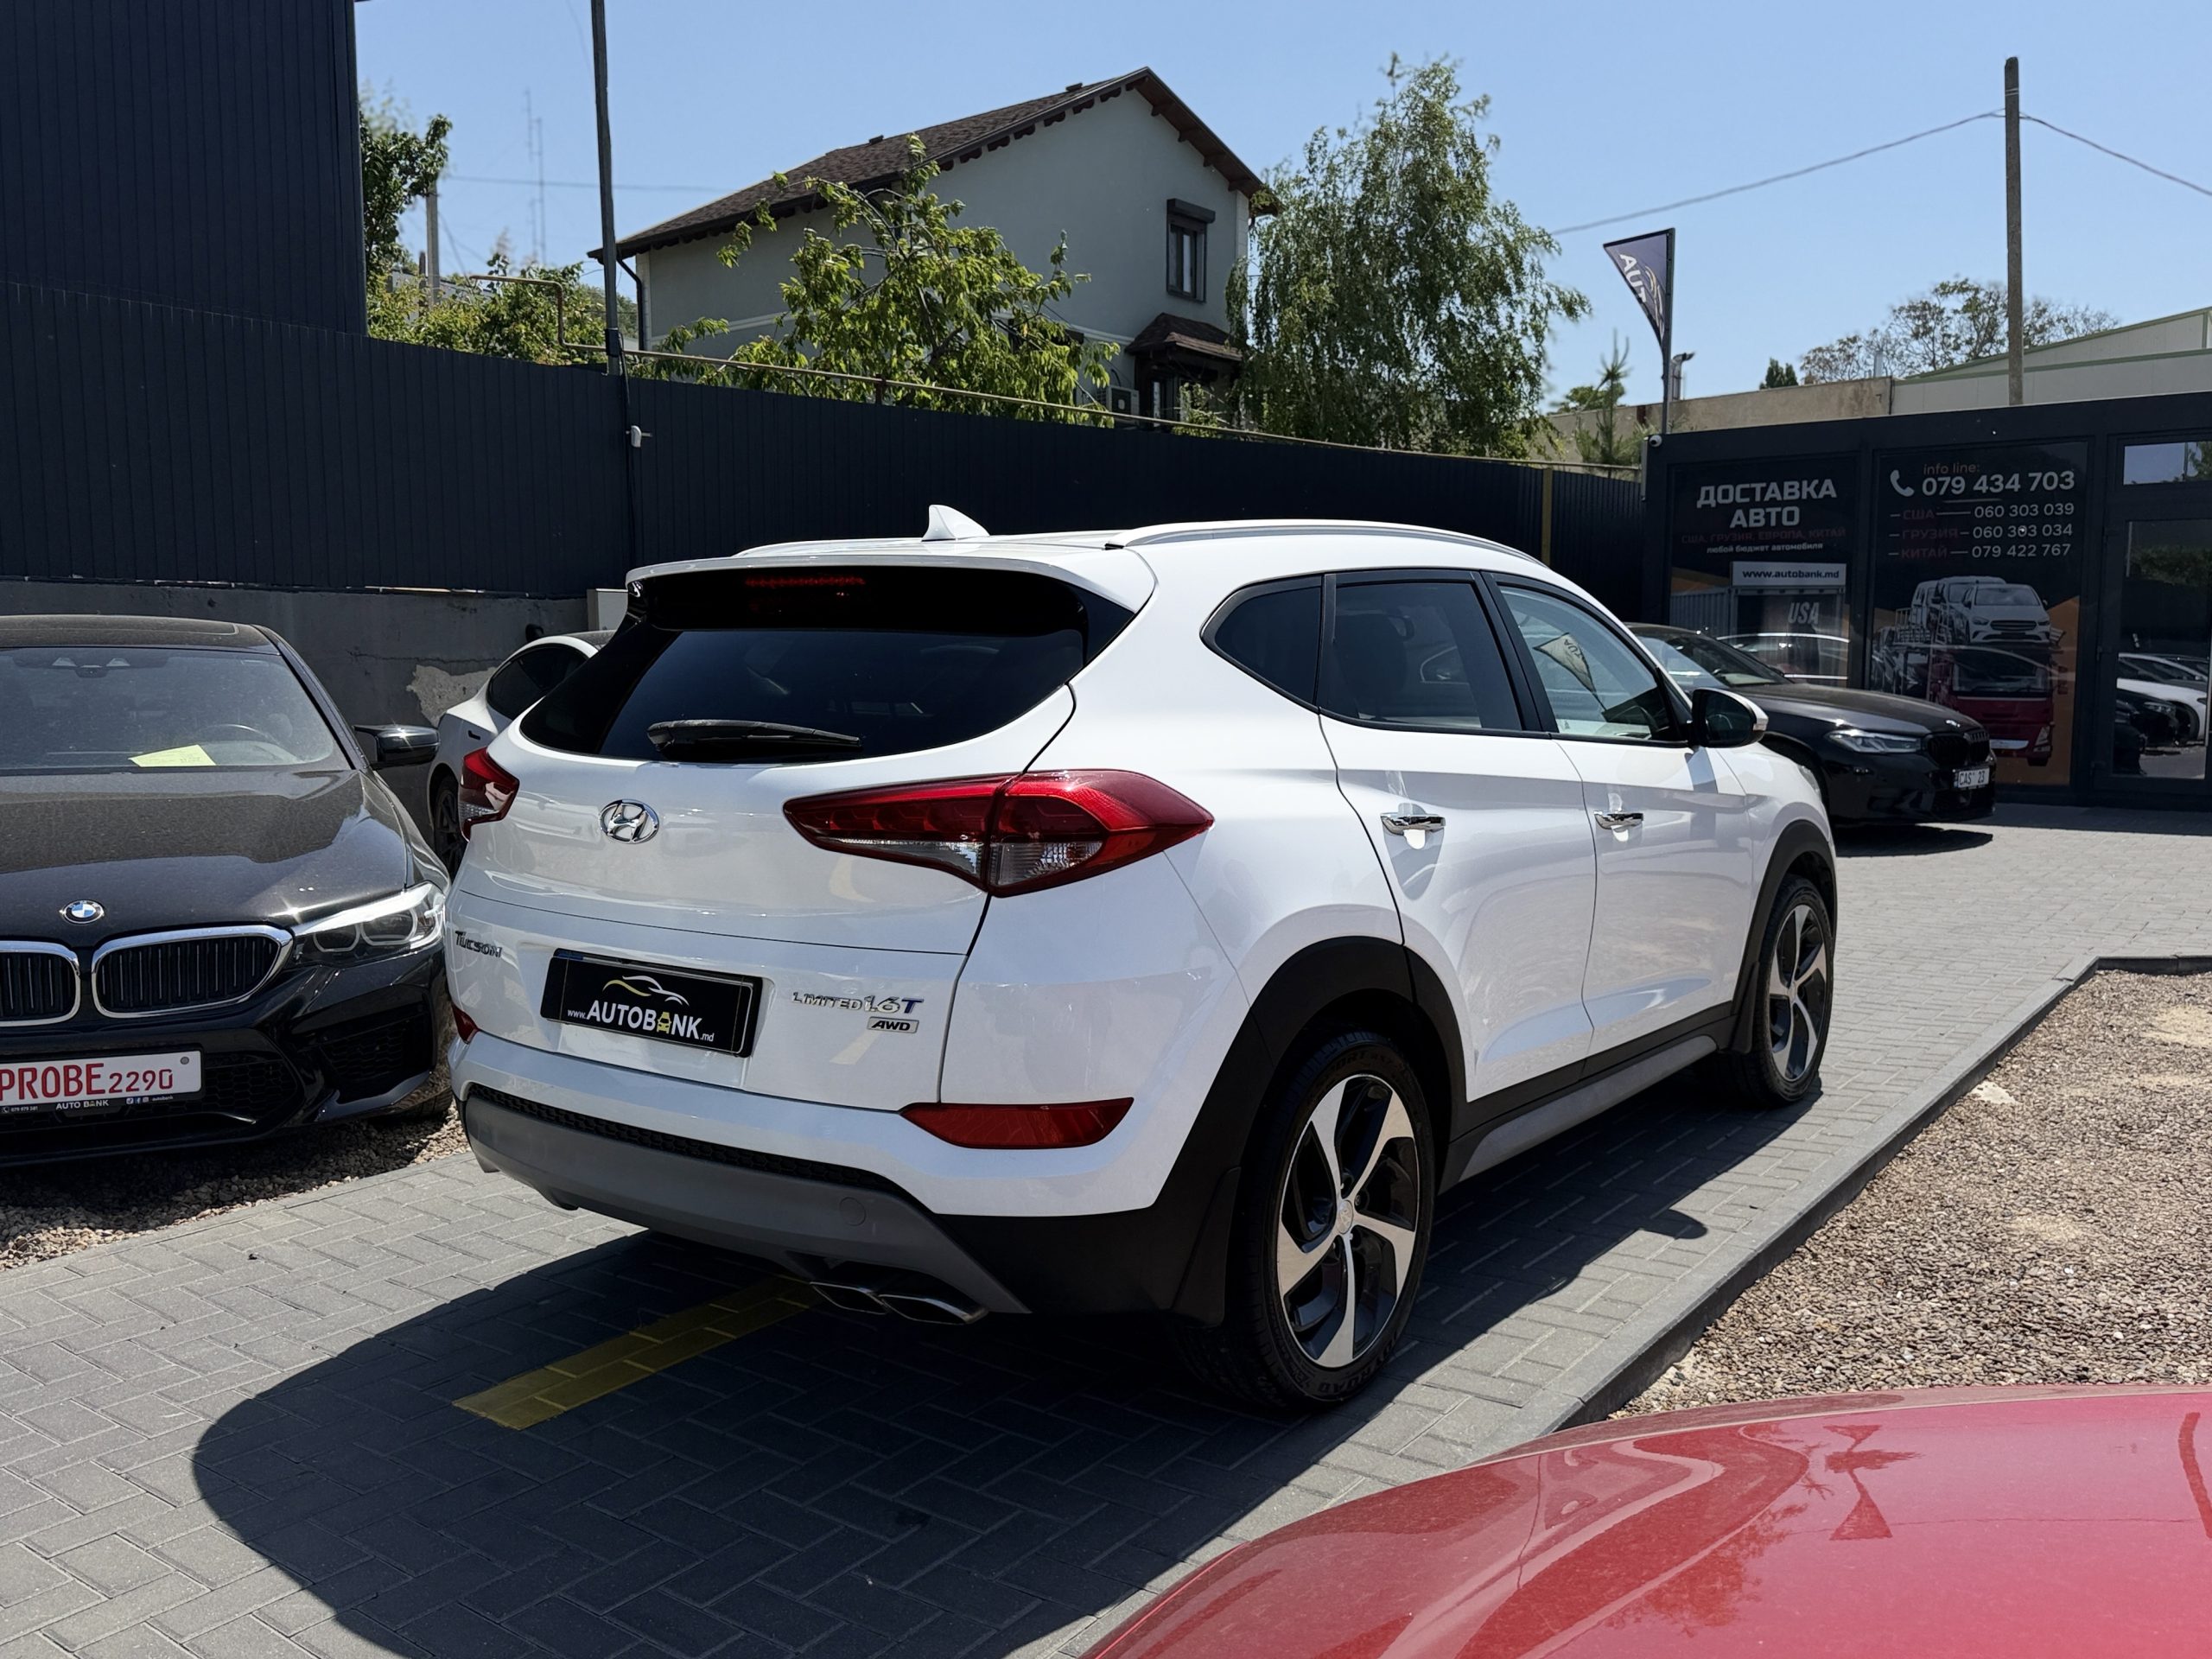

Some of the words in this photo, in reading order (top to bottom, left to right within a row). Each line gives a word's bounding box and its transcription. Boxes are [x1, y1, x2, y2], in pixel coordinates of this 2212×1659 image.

[1923, 463, 1948, 475] info
[1953, 462, 1980, 474] line:
[1922, 476, 1966, 496] 079
[1973, 473, 2021, 494] 434
[2028, 470, 2075, 492] 703
[1696, 479, 1837, 508] ДОСТАВКА
[1729, 505, 1800, 529] АВТО
[1903, 509, 1936, 520] США
[1974, 505, 2005, 518] 060
[2009, 505, 2039, 518] 303
[2044, 503, 2074, 516] 039
[1808, 526, 1847, 538] КИТАЙ
[1903, 528, 1959, 539] ГРУЗИЯ
[1973, 525, 2003, 538] 060
[2007, 524, 2037, 537] 303
[2042, 523, 2073, 537] 034
[1735, 543, 1770, 553] бюджет
[1771, 543, 1823, 551] автомобиля
[1901, 545, 1948, 558] КИТАЙ
[1972, 545, 2002, 558] 079
[2006, 543, 2037, 557] 422
[2042, 543, 2071, 556] 767
[1742, 570, 1840, 579] www.autobank.md
[1787, 601, 1820, 625] USA
[791, 992, 862, 1010] LIMITED
[872, 1020, 911, 1031] AWD
[0, 1063, 105, 1102] PROBE
[108, 1069, 173, 1094] 2290
[55, 1101, 81, 1110] AUTO
[83, 1099, 109, 1109] BANK
